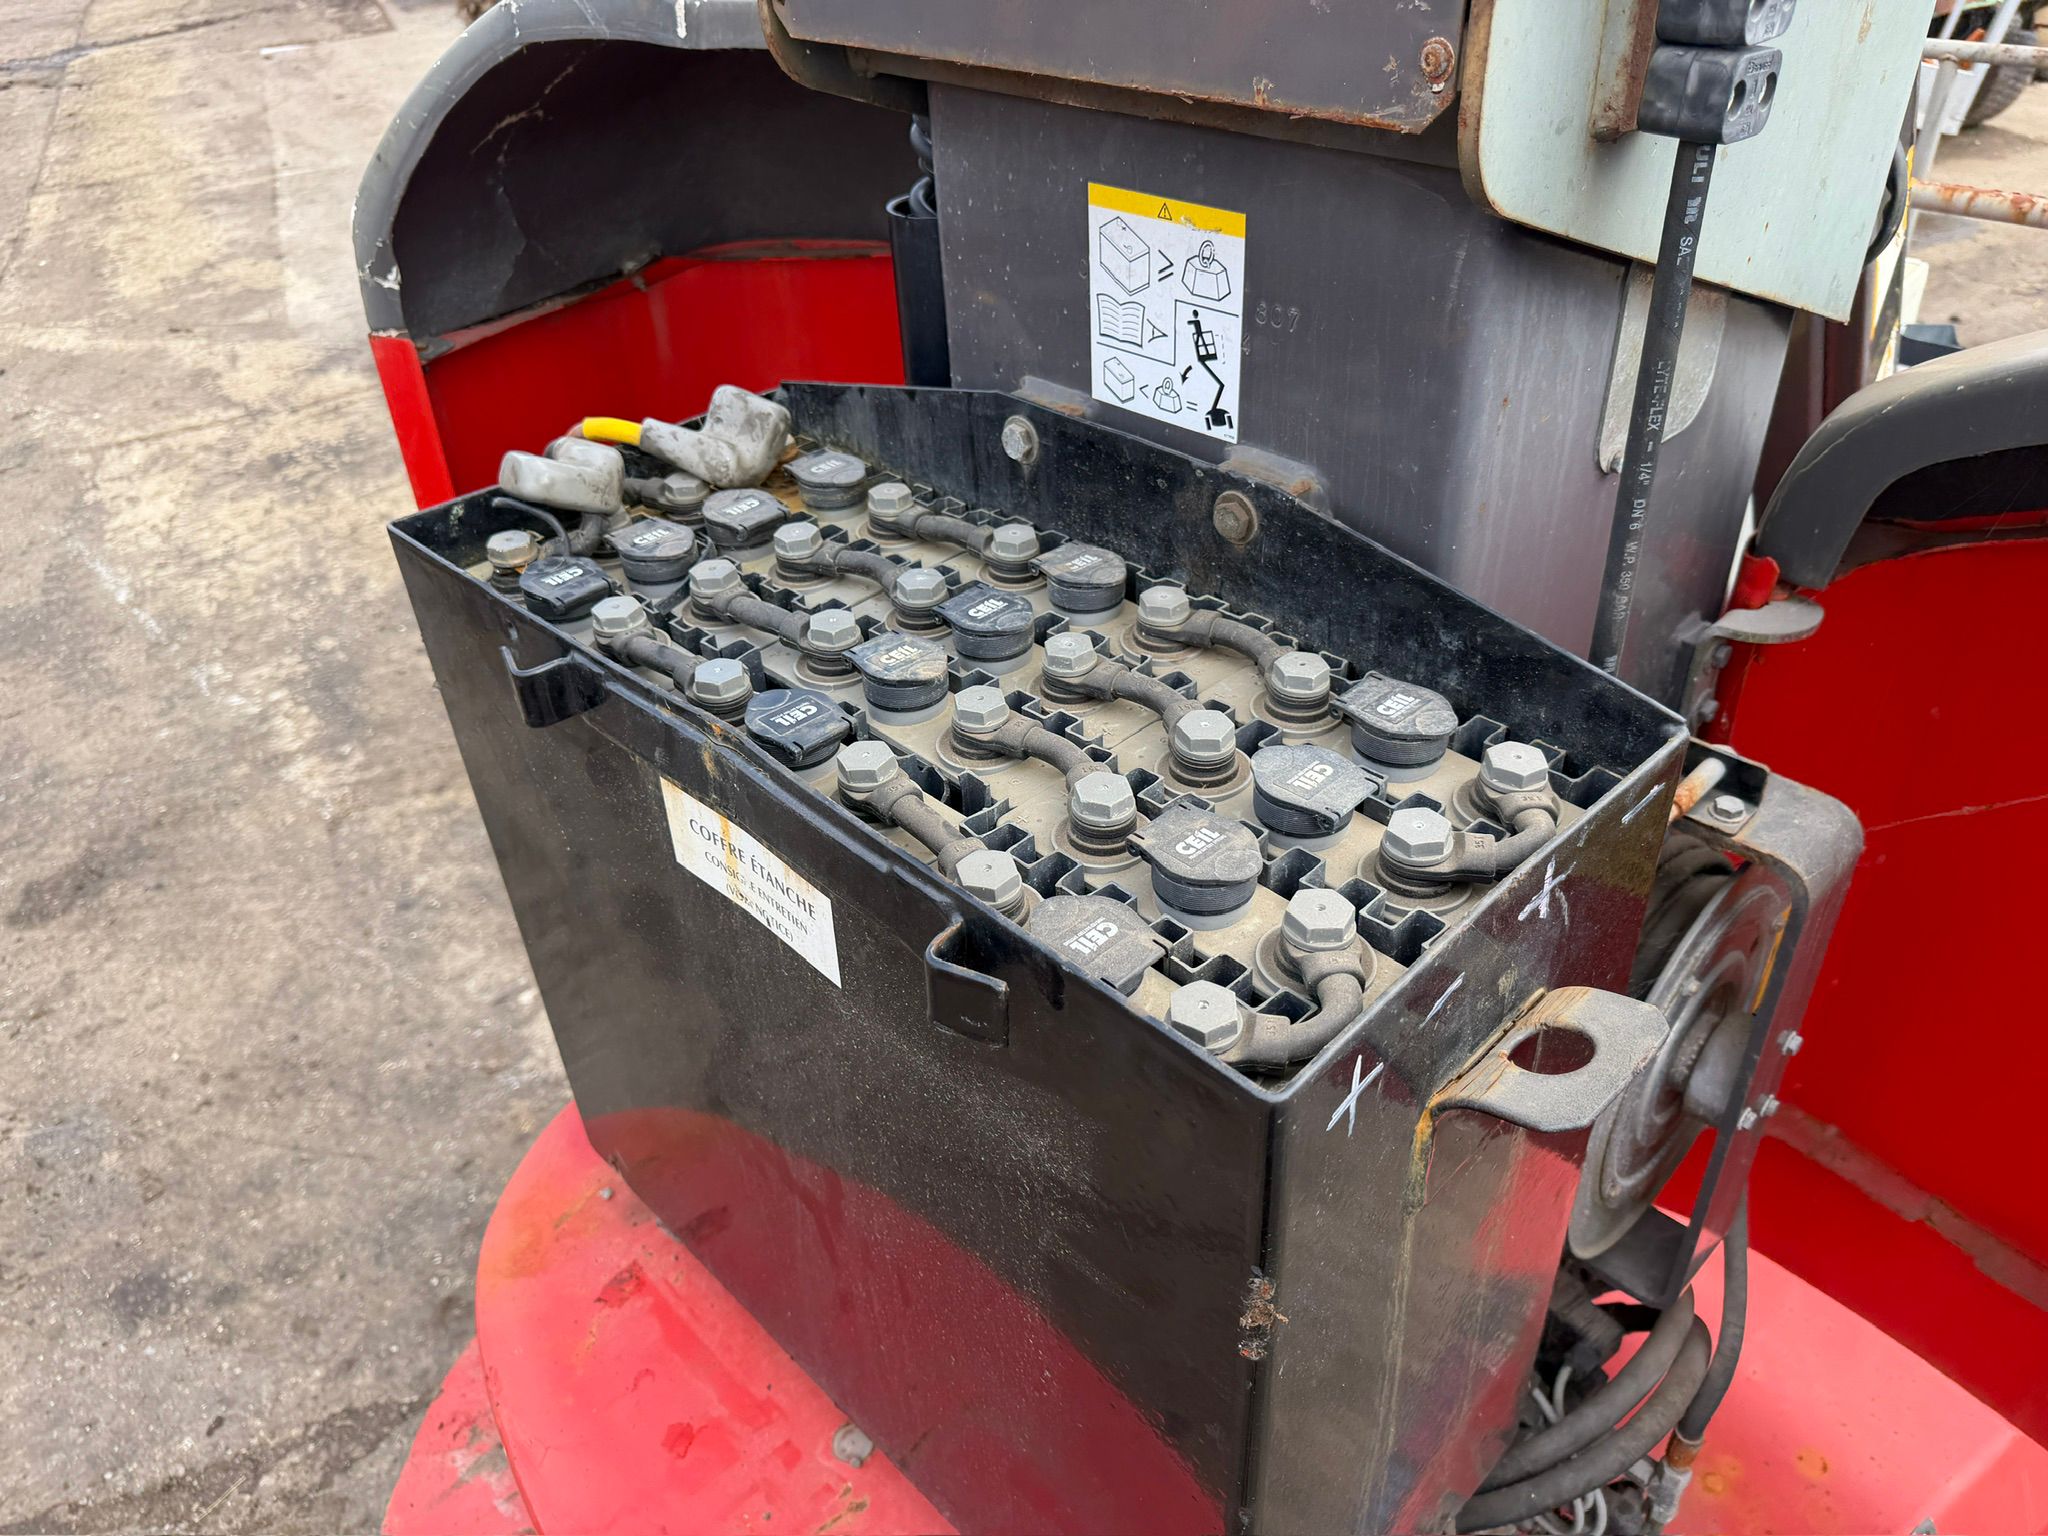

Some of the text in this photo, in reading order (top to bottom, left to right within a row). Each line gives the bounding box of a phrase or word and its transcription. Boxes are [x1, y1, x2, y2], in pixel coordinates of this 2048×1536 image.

[1631, 499, 1646, 517] DN
[689, 819, 817, 921] COFFRE ÉTANCHE
[705, 851, 808, 936] CONSIGE ENTRETIEN
